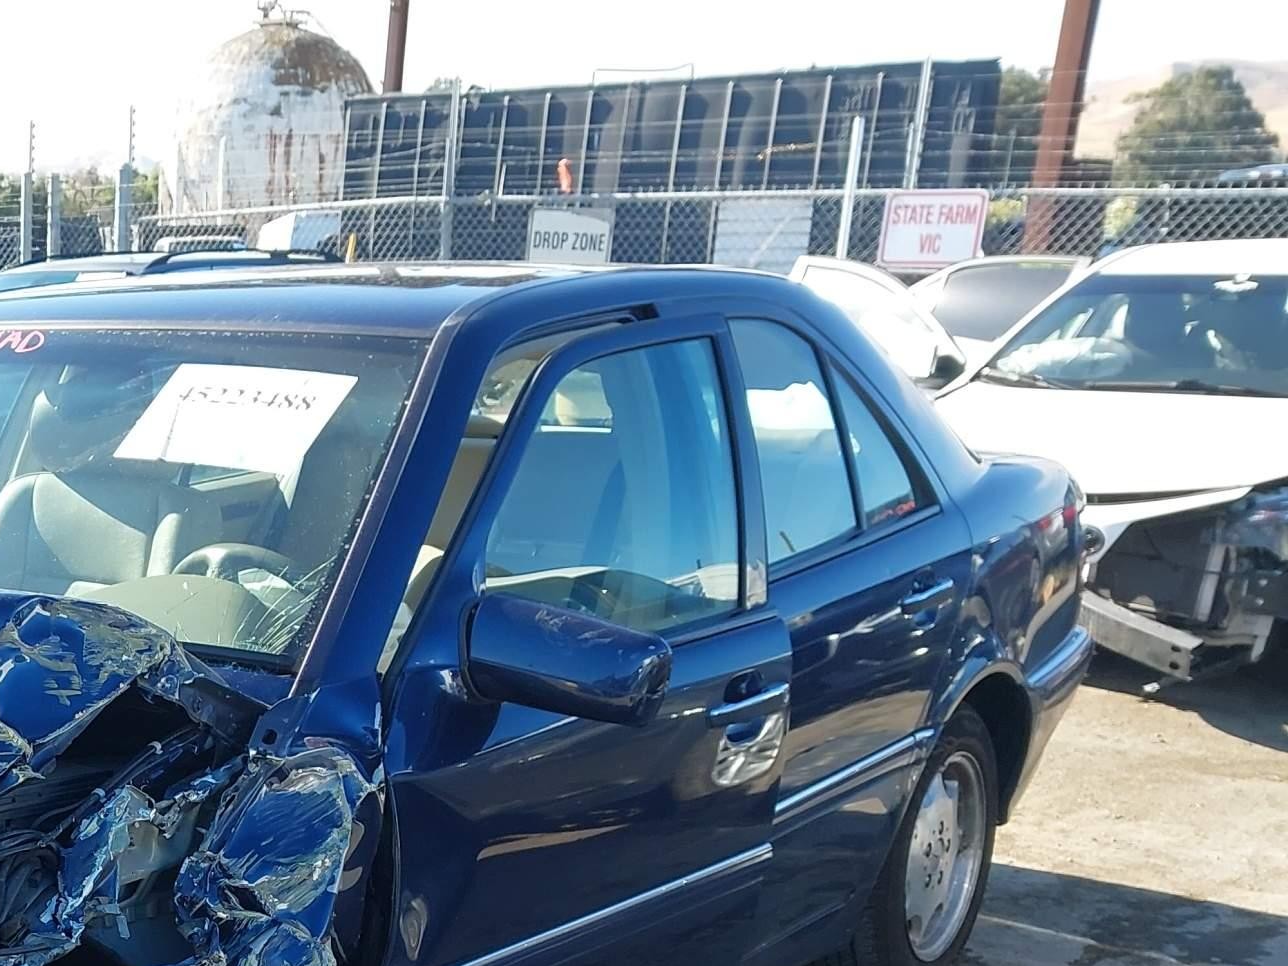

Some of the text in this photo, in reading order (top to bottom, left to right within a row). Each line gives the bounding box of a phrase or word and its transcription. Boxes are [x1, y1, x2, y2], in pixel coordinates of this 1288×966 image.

[891, 203, 979, 225] STATE FARM
[533, 230, 606, 252] DROP ZONE
[919, 232, 942, 254] VIC
[178, 386, 317, 411] 45223488
